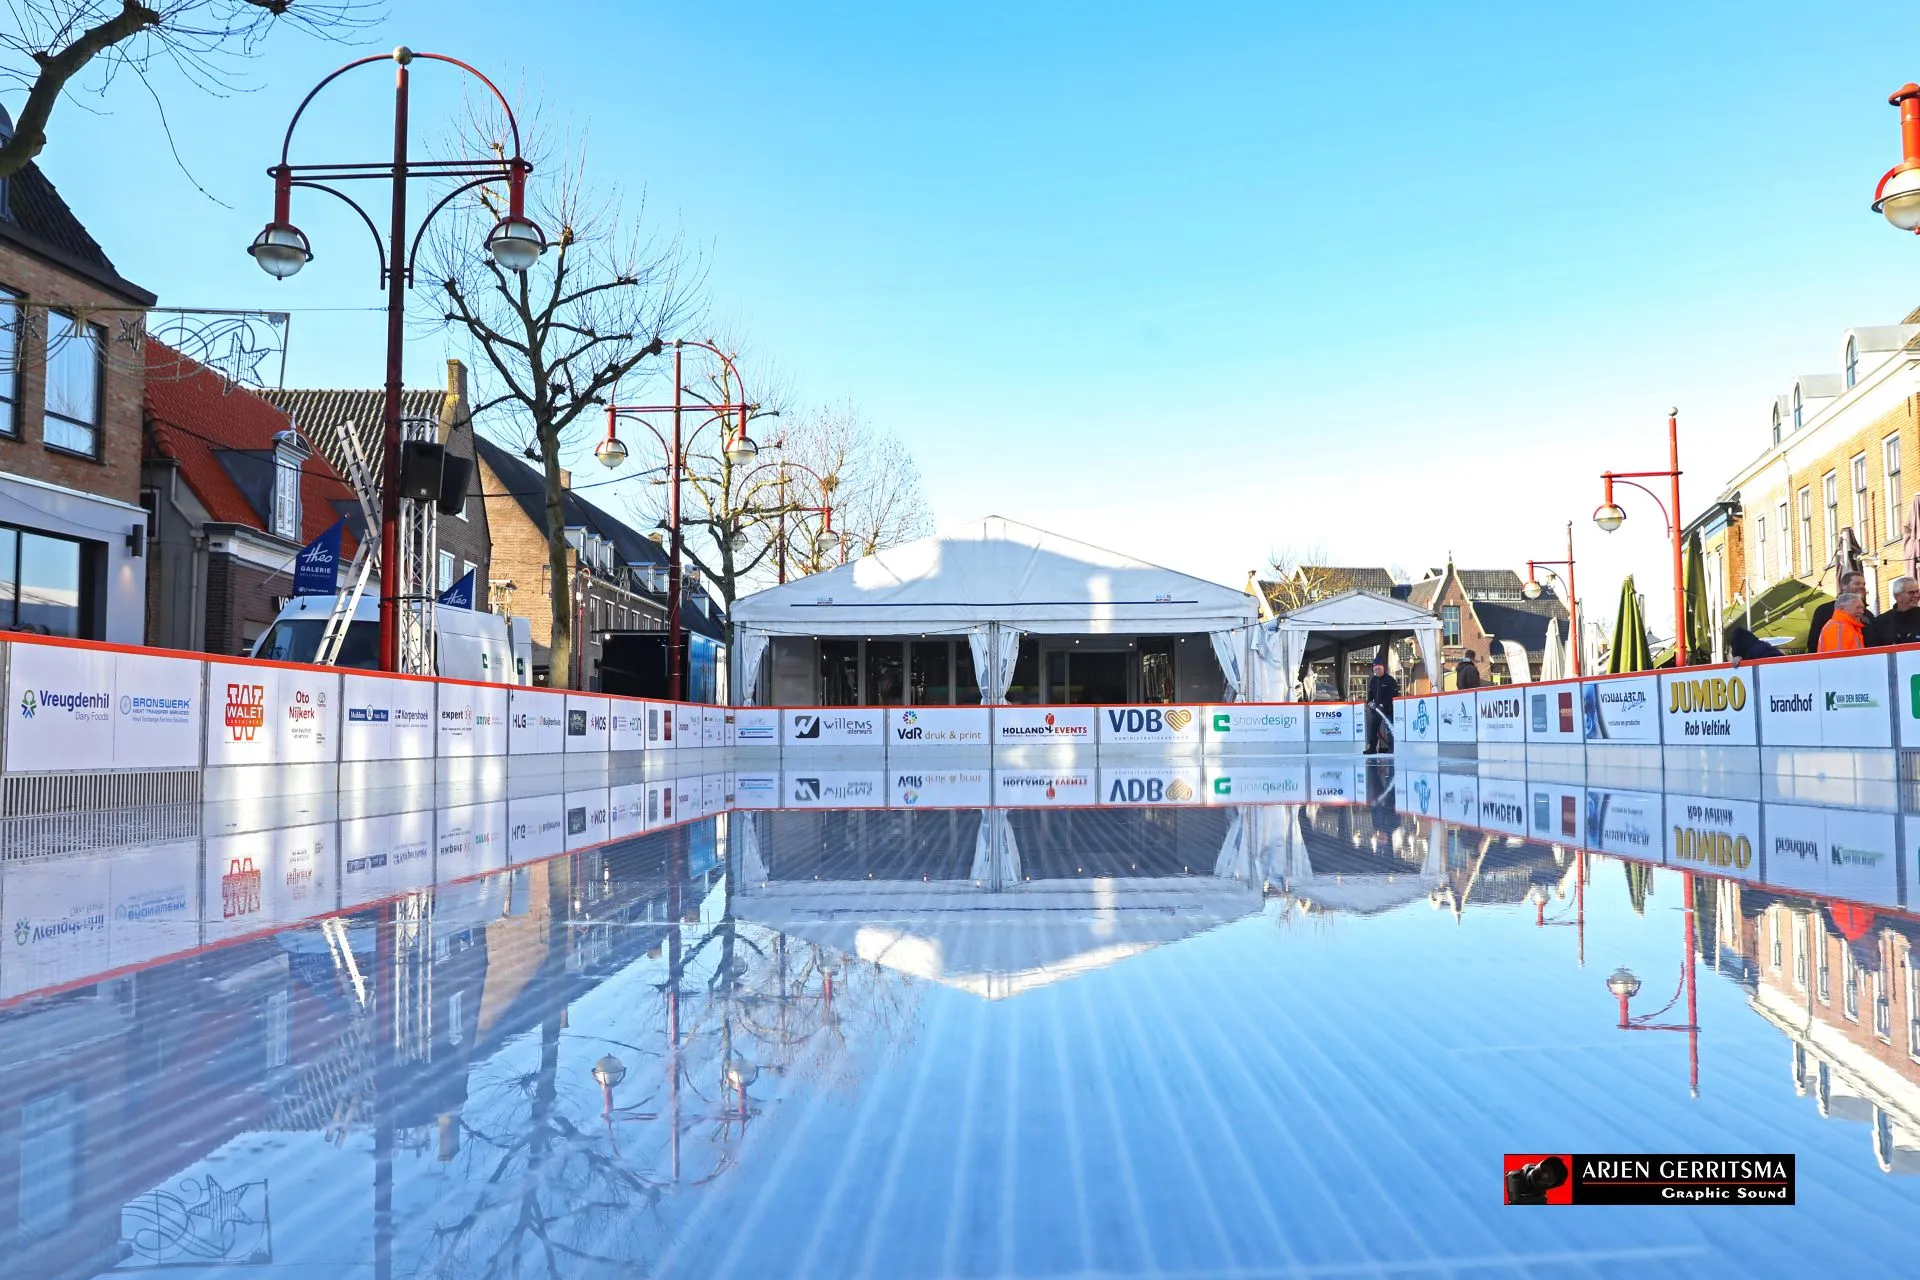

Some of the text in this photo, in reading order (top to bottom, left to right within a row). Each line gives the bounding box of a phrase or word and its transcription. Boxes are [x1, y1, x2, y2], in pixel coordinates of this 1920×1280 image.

[301, 566, 331, 574] GALERIE
[40, 690, 110, 712] Vreugdenhil
[295, 691, 309, 703] Oto
[1669, 676, 1747, 713] JUMBO
[1837, 695, 1845, 703] VAN
[1846, 694, 1854, 702] DEN
[133, 698, 190, 709] BRONSWERK
[1480, 699, 1520, 718] MANDELO
[1770, 693, 1812, 712] brandhof
[75, 711, 109, 722] Dairy Foods
[227, 706, 263, 718] WALET
[289, 706, 315, 722] Nijkerk
[441, 711, 463, 720] expert
[512, 714, 527, 729] HLG
[1108, 709, 1163, 732] VDB
[1233, 714, 1297, 728] showdesign
[1685, 718, 1731, 736] Rob Veltink
[897, 727, 982, 742] VdR druk & print
[1054, 726, 1087, 734] EVENTS
